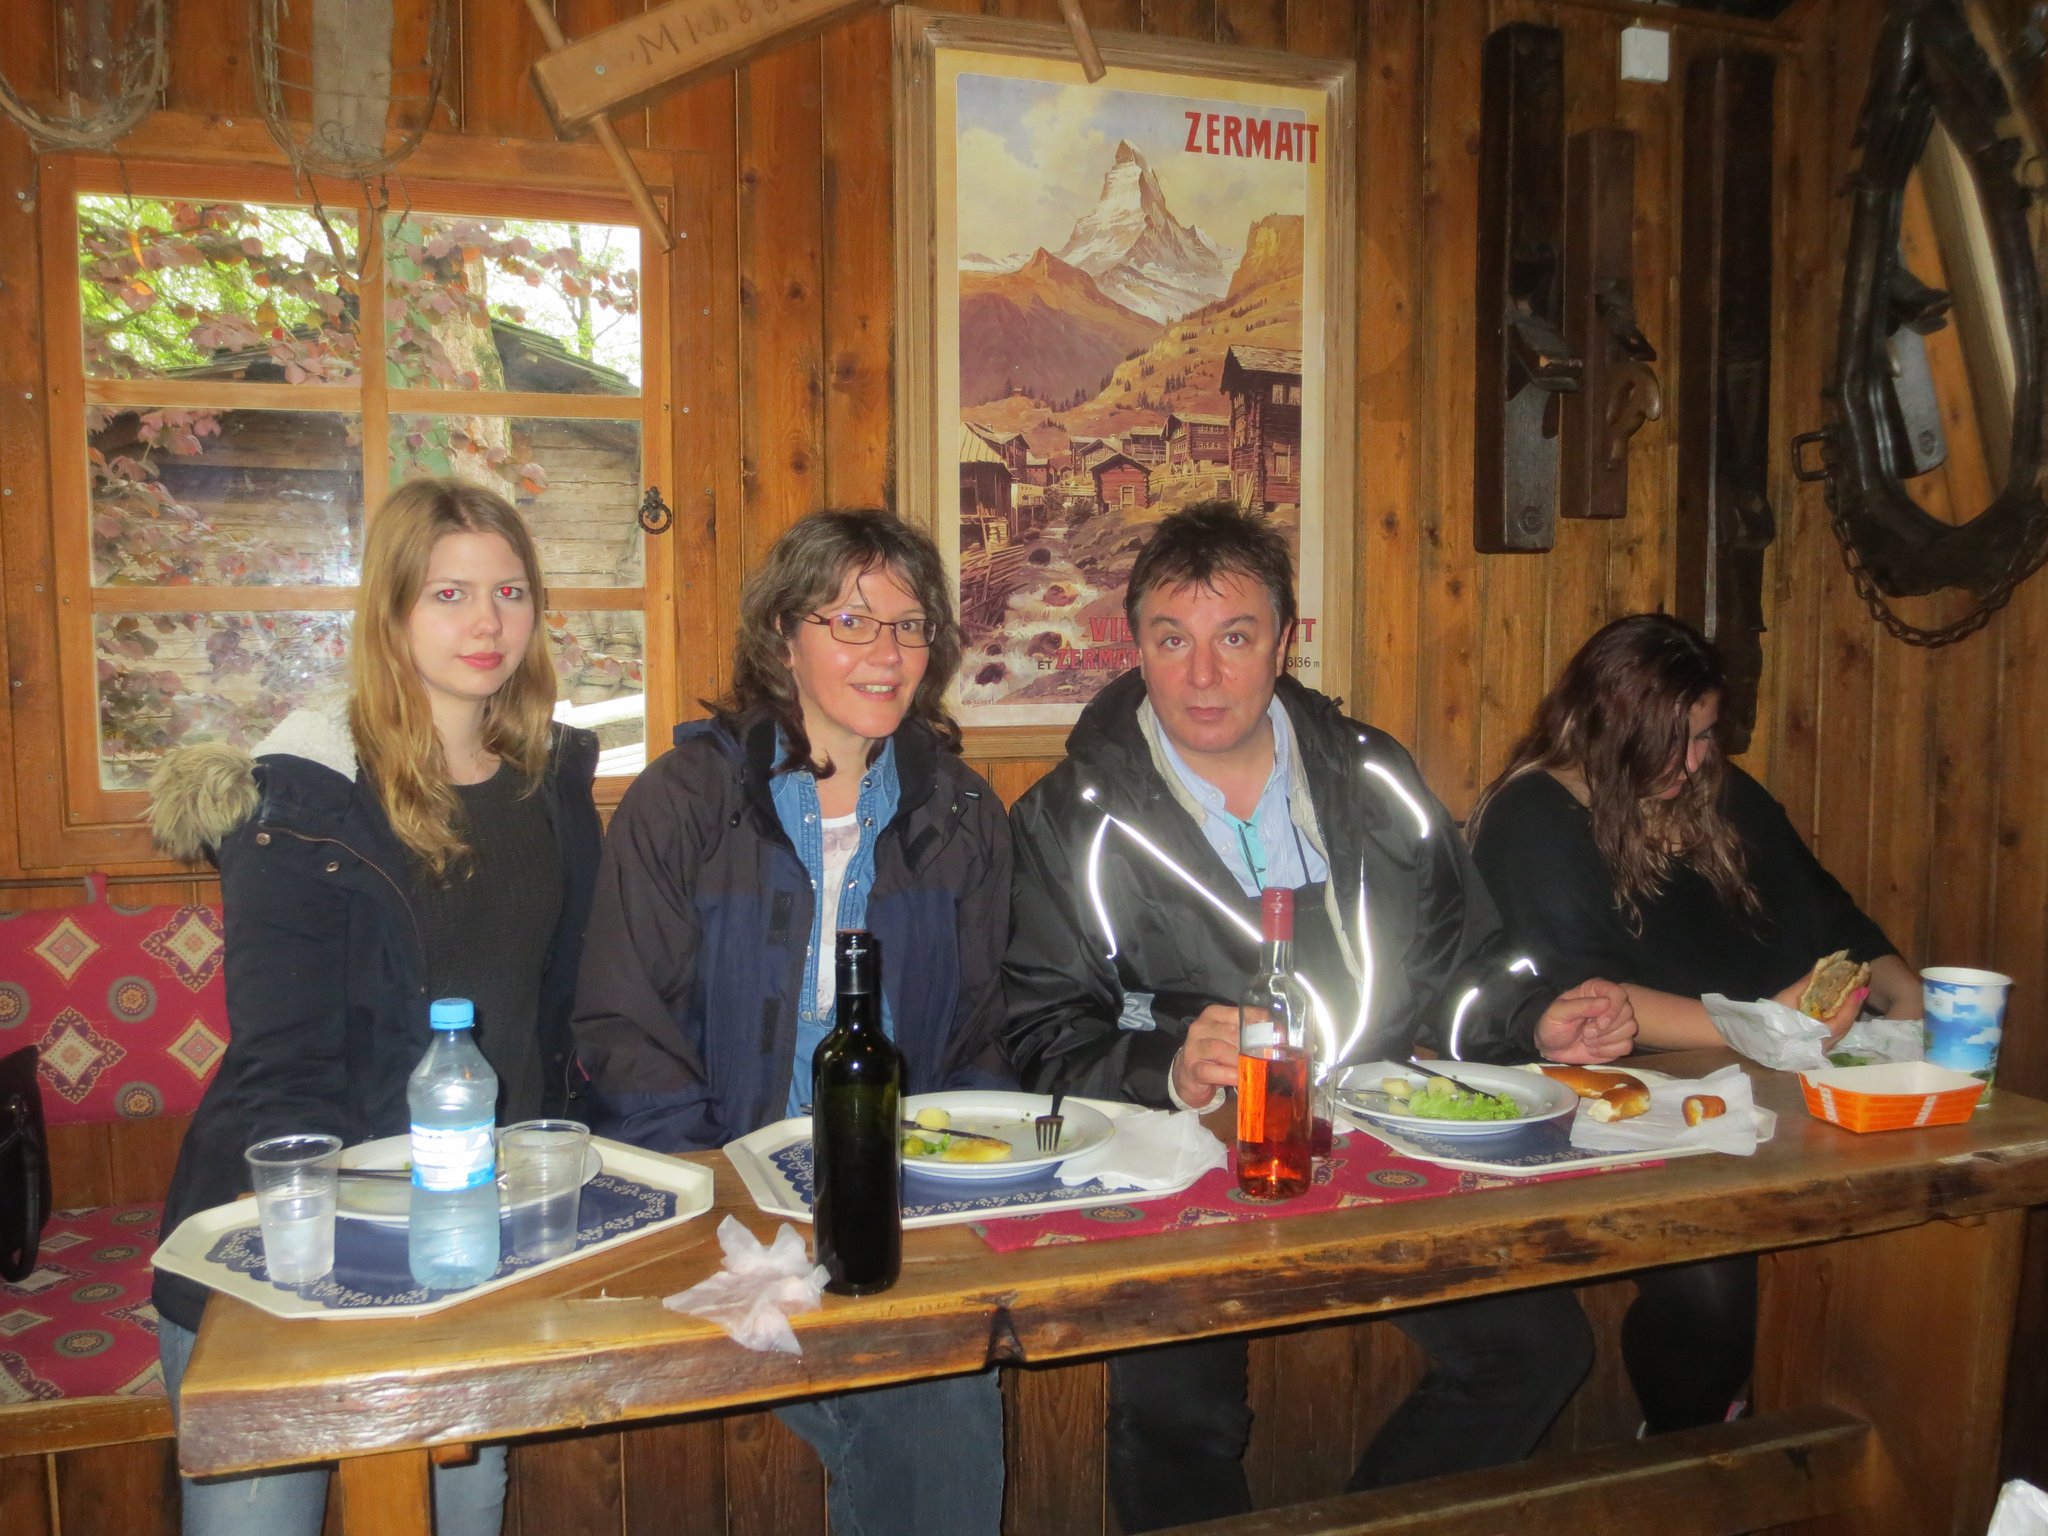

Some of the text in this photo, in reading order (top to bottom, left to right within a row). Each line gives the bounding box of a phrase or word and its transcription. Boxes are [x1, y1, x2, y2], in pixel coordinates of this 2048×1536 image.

[1185, 111, 1320, 164] ZERMATT
[1037, 660, 1052, 670] ET
[1287, 656, 1311, 668] 3136
[1313, 660, 1320, 668] m
